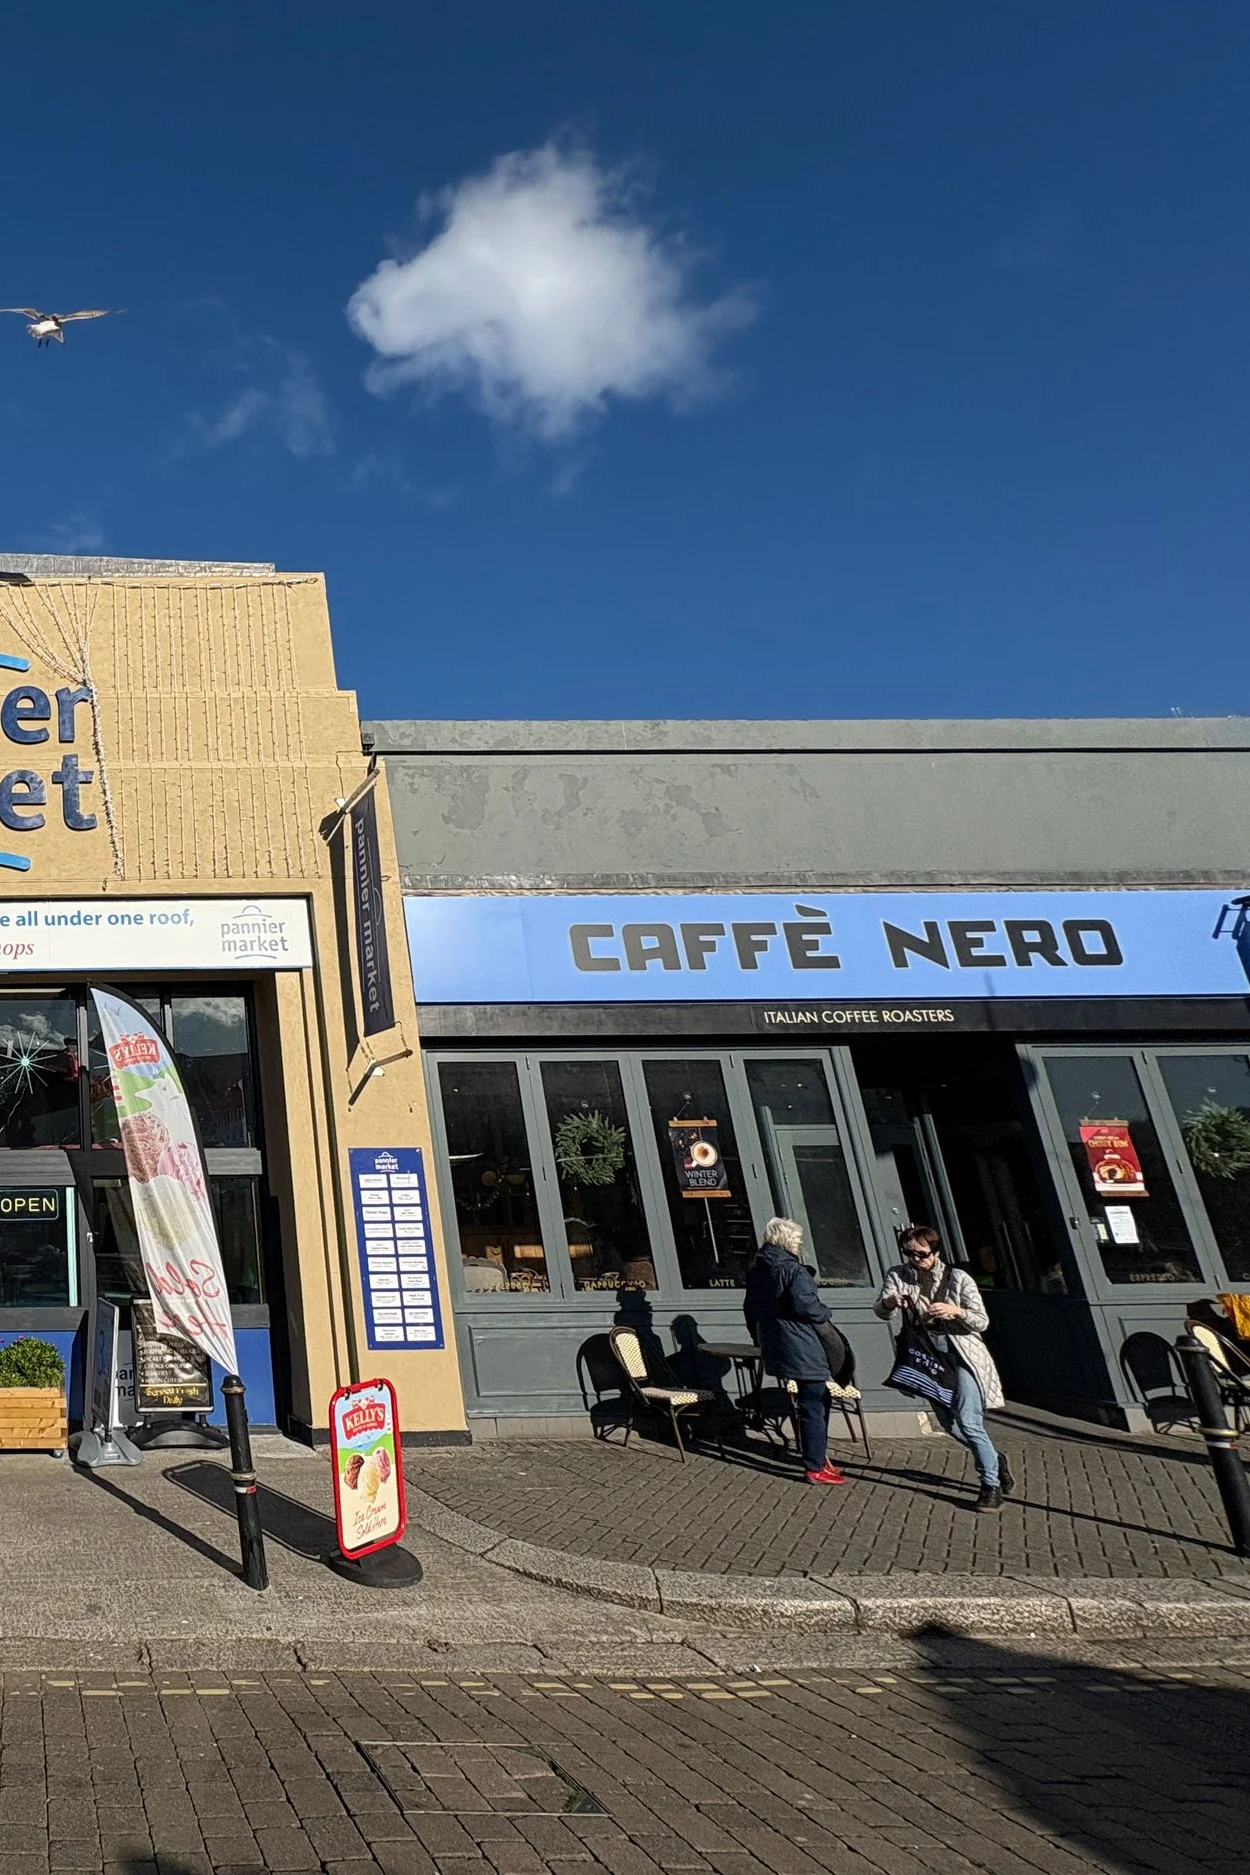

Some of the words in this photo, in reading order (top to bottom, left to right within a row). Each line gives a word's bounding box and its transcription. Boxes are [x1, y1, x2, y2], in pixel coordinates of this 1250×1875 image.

[355, 819, 371, 912] pannier
[16, 911, 39, 927] all
[44, 910, 102, 926] under
[107, 914, 144, 926] one
[149, 909, 195, 927] roof,
[220, 917, 286, 937] pannier
[221, 935, 289, 952] market
[569, 903, 842, 972] CAFFÈ
[882, 919, 1124, 971] NERO
[362, 920, 379, 1014] market
[764, 1011, 818, 1024] ITALIAN
[821, 1010, 879, 1023] COFFEE
[882, 1009, 955, 1022] ROASTERS
[684, 1170, 719, 1178] WINTER
[690, 1178, 717, 1186] BLEND
[0, 1197, 56, 1212] OPEN
[709, 1279, 736, 1287] LATTE
[145, 1387, 175, 1397] Served
[345, 1406, 385, 1431] KELLY'S
[353, 1510, 365, 1528] Ice
[366, 1502, 387, 1520] Cream
[356, 1519, 372, 1540] Sold
